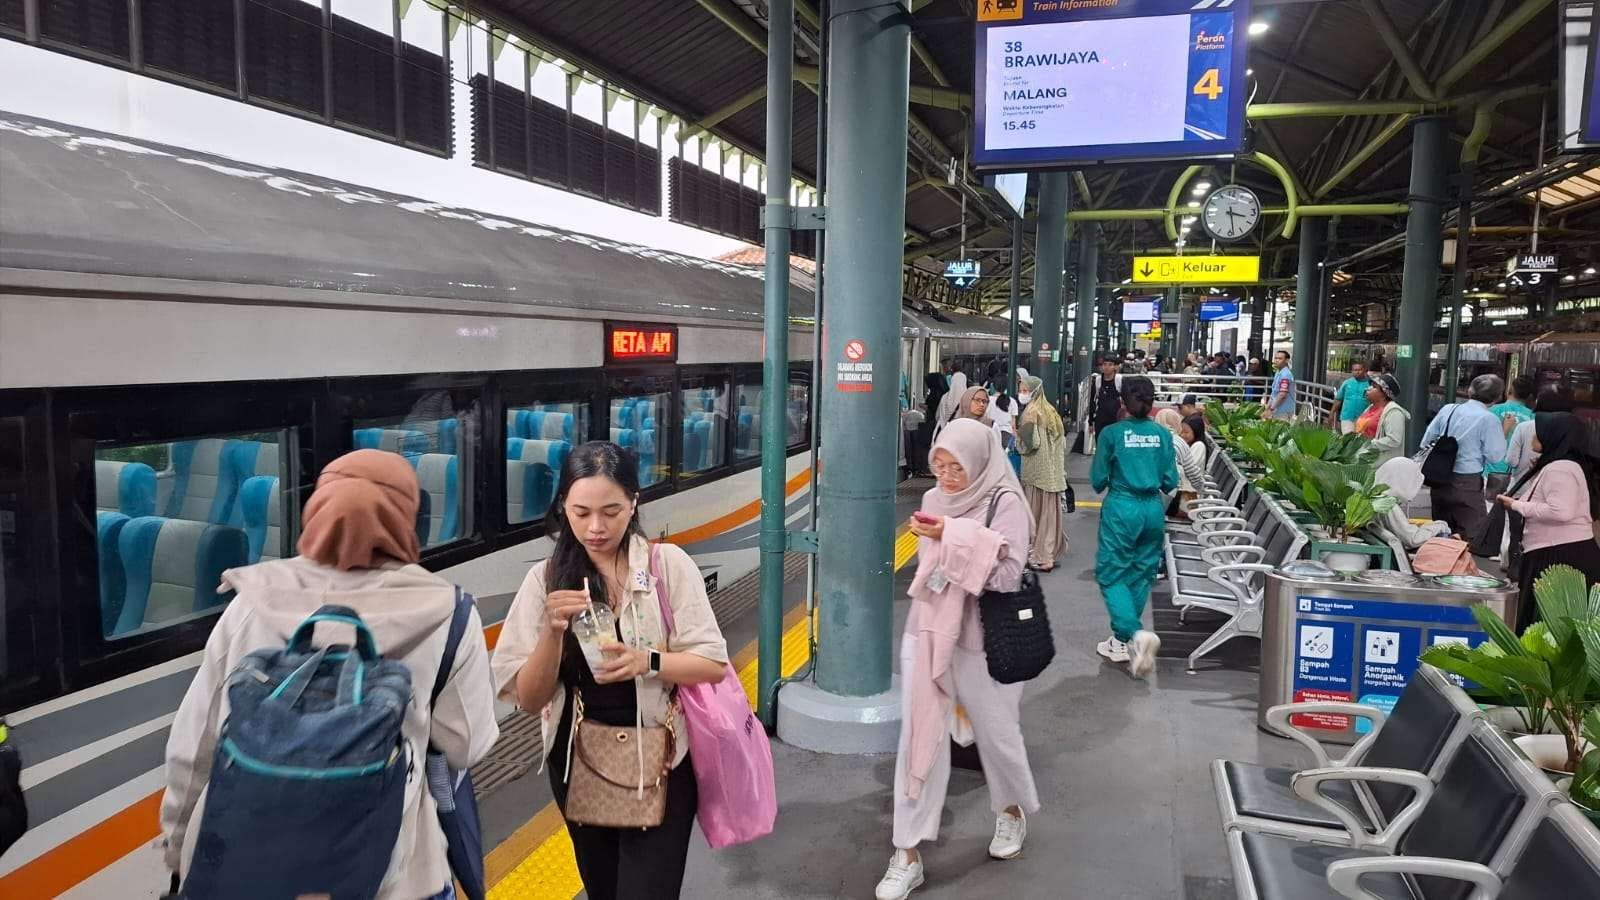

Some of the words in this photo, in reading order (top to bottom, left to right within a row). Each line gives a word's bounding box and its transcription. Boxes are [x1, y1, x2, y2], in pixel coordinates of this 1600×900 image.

[1033, 2, 1057, 11] Train
[1060, 0, 1118, 10] Information
[1004, 41, 1022, 53] 38
[1004, 51, 1100, 68] BRAWIJAYA
[1193, 68, 1223, 100] 4
[1003, 87, 1068, 101] MALANG
[1003, 120, 1036, 131] 15.45
[947, 261, 973, 271] JALUR
[1523, 256, 1555, 265] JALUR
[1183, 261, 1226, 272] Keluar
[955, 278, 965, 286] 4
[1528, 273, 1541, 284] 3
[651, 332, 672, 353] API
[1300, 659, 1330, 669] Sampah
[1365, 665, 1396, 674] Sampah
[1365, 671, 1404, 681] Anorganik
